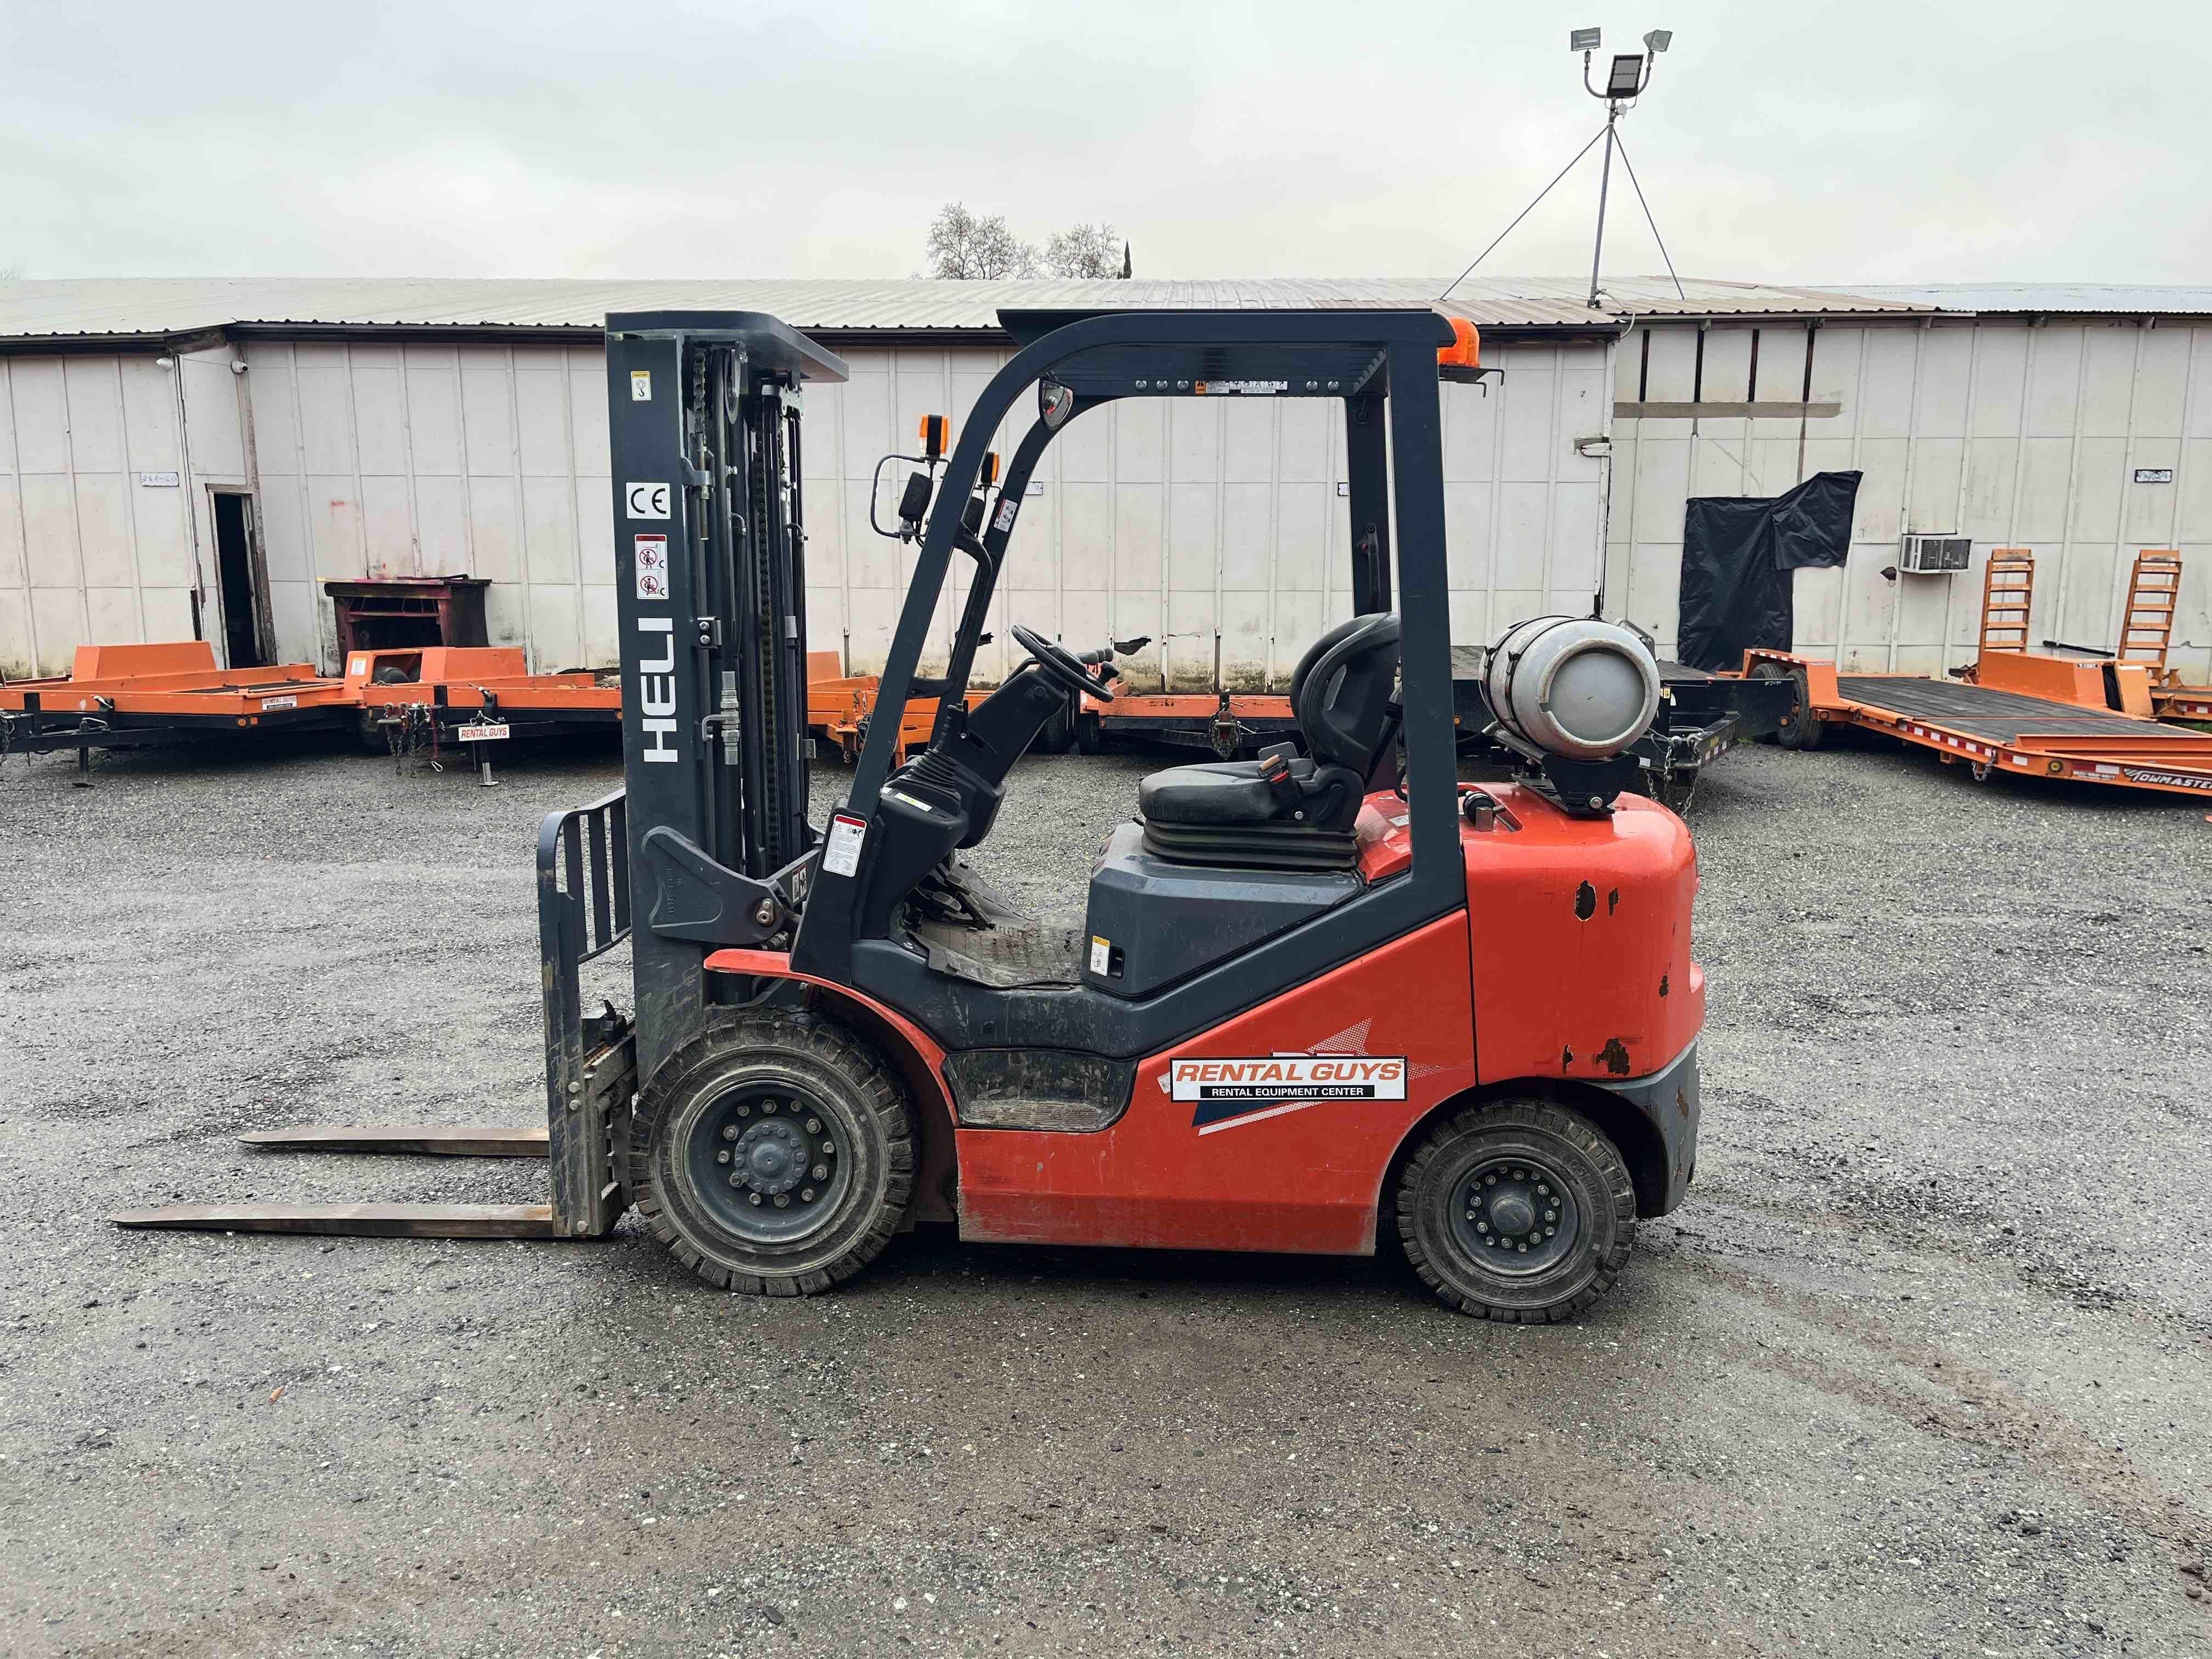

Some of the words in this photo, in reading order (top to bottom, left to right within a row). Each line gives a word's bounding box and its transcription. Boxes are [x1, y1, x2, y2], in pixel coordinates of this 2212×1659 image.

[631, 487, 667, 514] CE
[637, 618, 678, 762] HELI
[461, 728, 487, 738] RENTAL
[489, 727, 507, 736] GUYS
[1176, 1064, 1304, 1081] RENTAL
[1310, 1063, 1401, 1081] GUYS
[1255, 1088, 1319, 1096] EQUIPMENT
